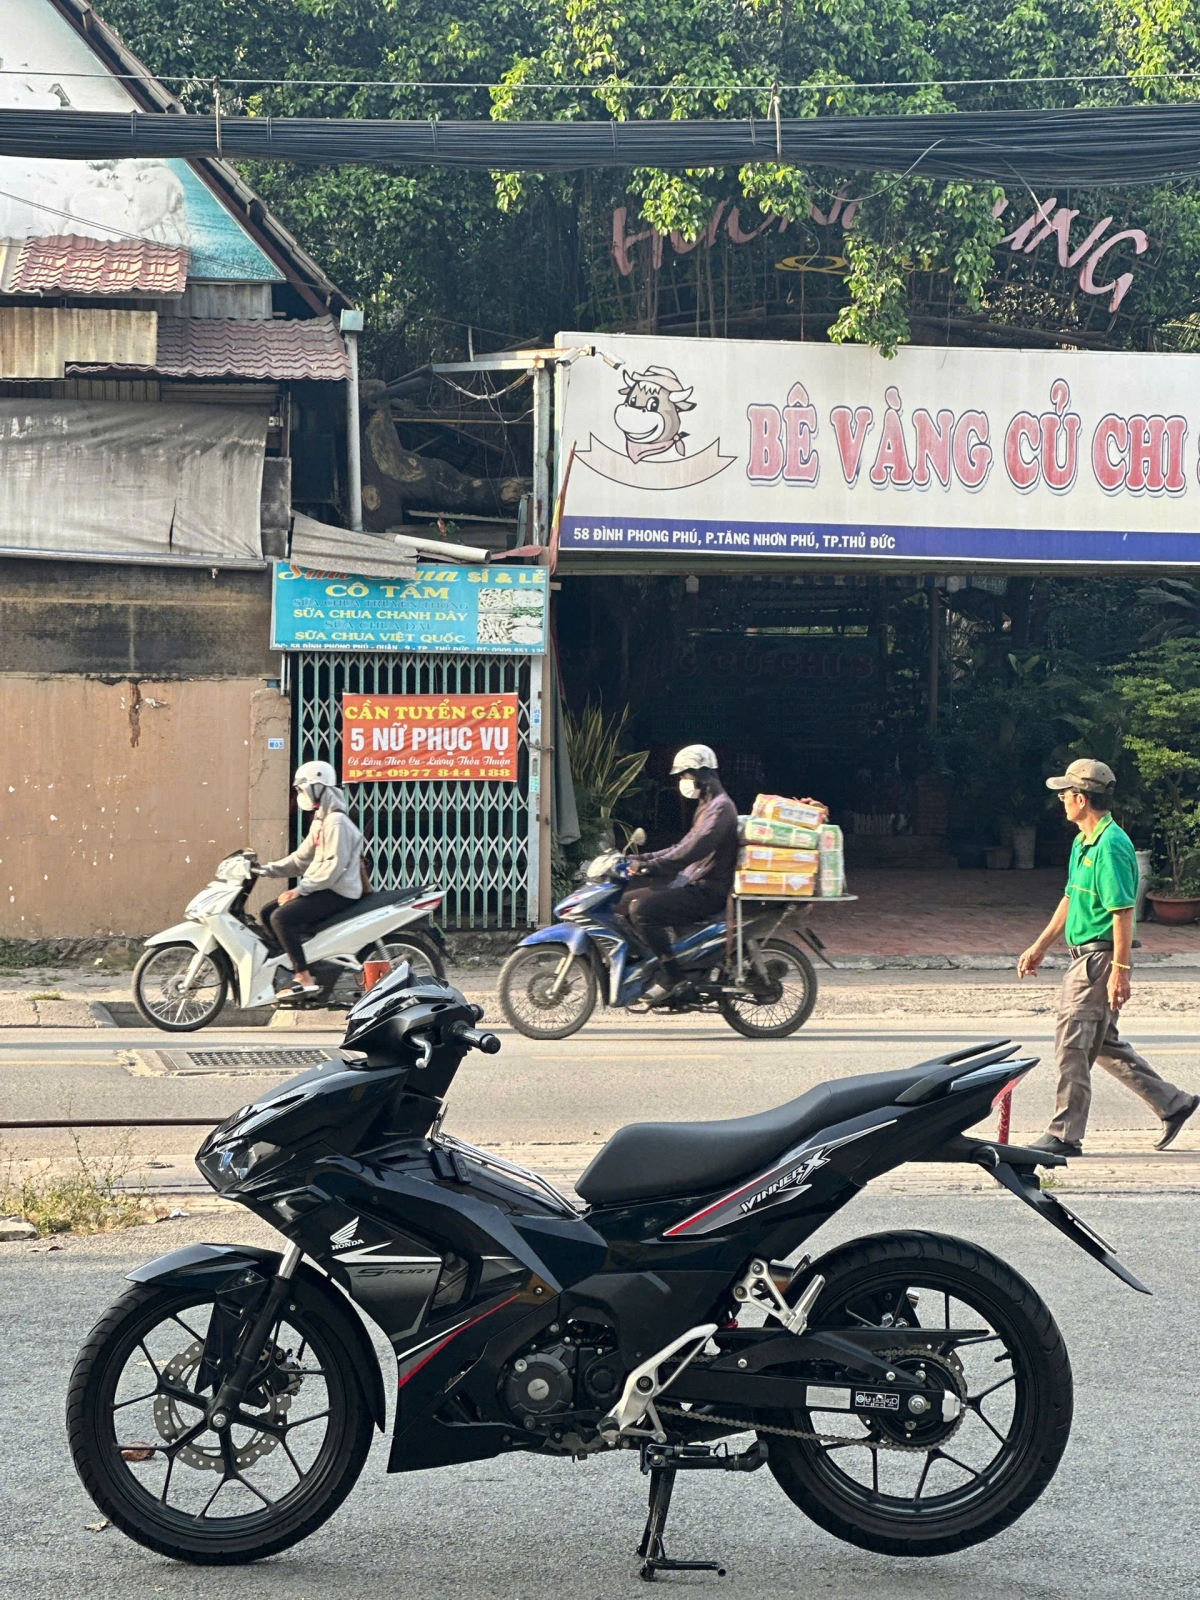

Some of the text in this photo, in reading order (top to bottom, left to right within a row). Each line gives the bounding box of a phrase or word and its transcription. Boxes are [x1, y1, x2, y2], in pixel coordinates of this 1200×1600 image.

[746, 381, 821, 487] BÊ
[829, 386, 994, 492] VÀNG
[1003, 377, 1083, 495] CỦ
[1091, 412, 1190, 498] CHI
[573, 525, 896, 549] 58 ĐÌNH PHONG PHÚ, P.TĂNG NHƠN PHÚ, TP.THỦ ĐỨC
[495, 573, 512, 583] &
[325, 580, 449, 599] CÔ TẤM
[325, 599, 361, 608] CHUA
[293, 607, 468, 621] SỮA CHUA CHANH DÂY
[359, 620, 400, 630] CHUA
[294, 629, 466, 644] SỮA CHUA VIỆT QUỐC
[345, 699, 389, 720] CẦN
[394, 699, 466, 720] TUYỂN
[471, 700, 515, 719] GẤP
[350, 723, 509, 756] 5 NỮ PHỤC VỤ
[361, 757, 382, 766] Làm
[384, 756, 406, 766] Theo
[408, 756, 420, 766] Ca
[387, 769, 431, 777] 0977
[331, 1239, 365, 1251] HONDA
